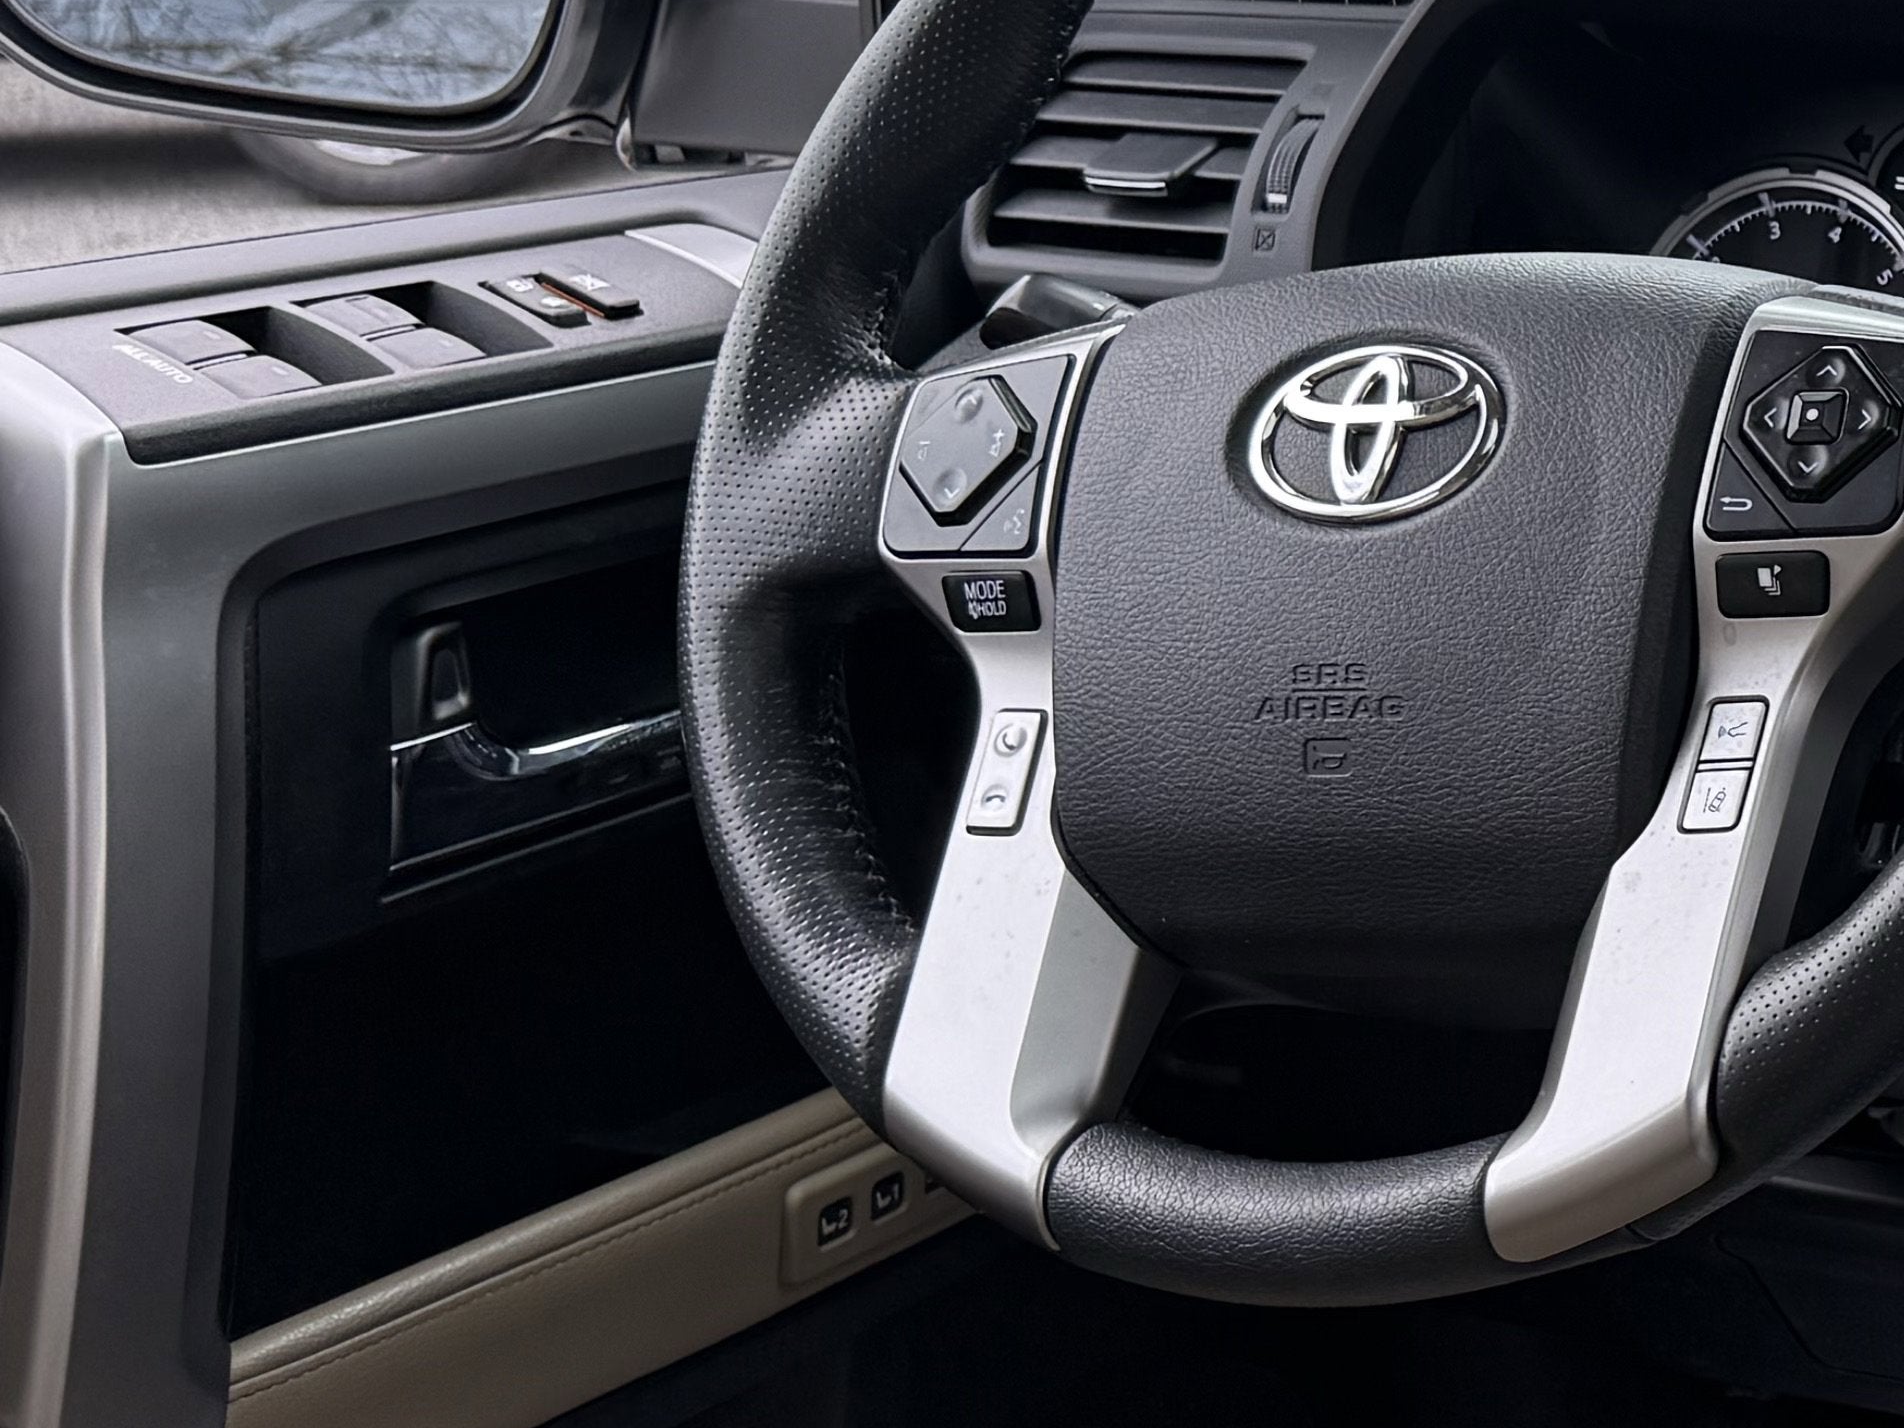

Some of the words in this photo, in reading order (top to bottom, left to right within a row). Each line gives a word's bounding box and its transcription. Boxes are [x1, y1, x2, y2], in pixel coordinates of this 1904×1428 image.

[1768, 220, 1782, 241] 3
[1827, 226, 1842, 244] 4
[1875, 269, 1892, 287] 5
[143, 359, 194, 384] AUTO
[963, 579, 1006, 601] MODE
[1292, 662, 1368, 686] SRS
[1253, 693, 1406, 722] AIRBAG
